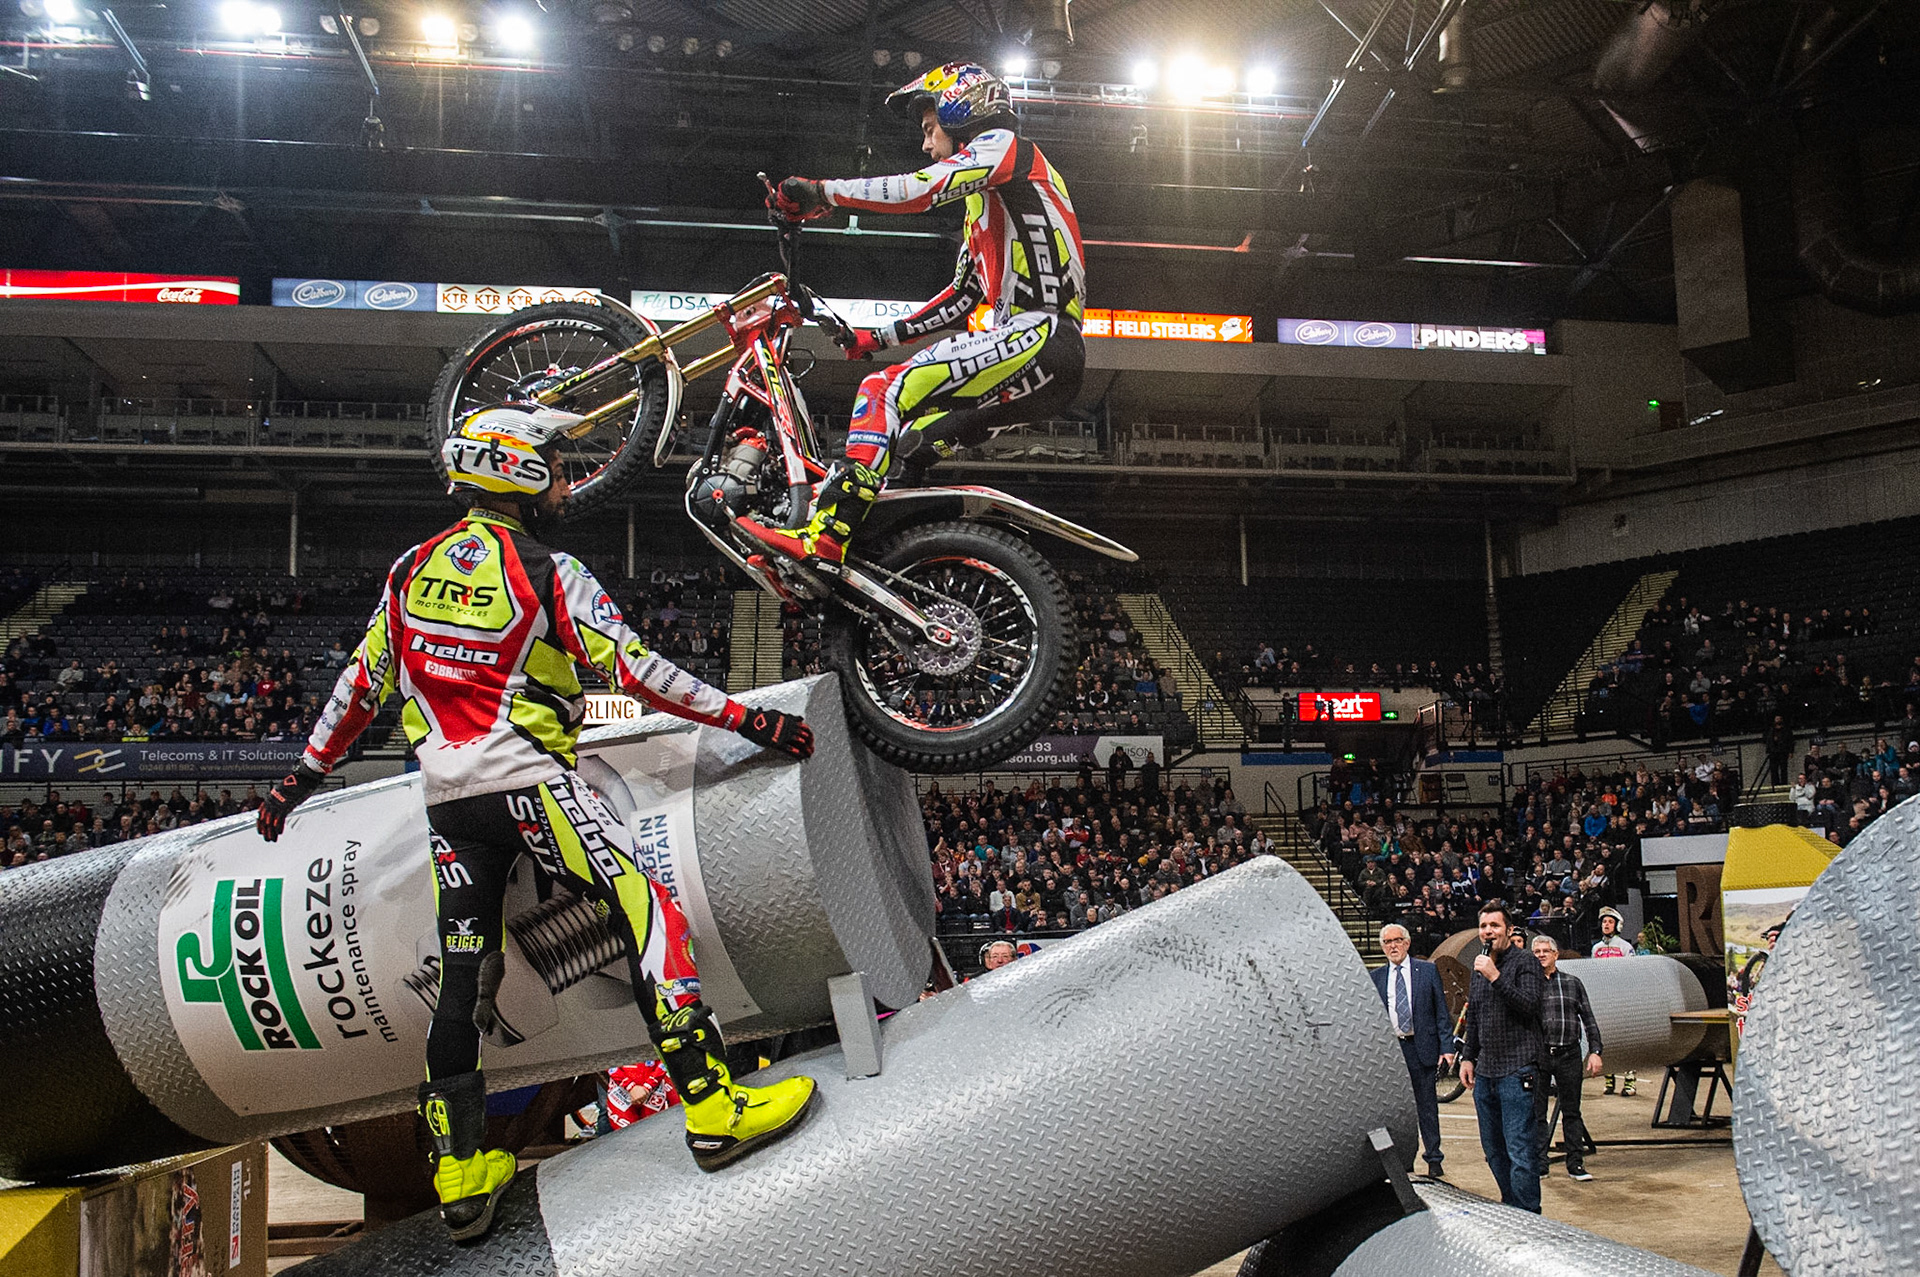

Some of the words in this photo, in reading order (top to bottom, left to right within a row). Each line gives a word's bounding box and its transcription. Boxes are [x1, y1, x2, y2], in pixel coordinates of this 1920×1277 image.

[943, 78, 971, 103] Red
[932, 175, 988, 203] hebo
[298, 285, 338, 302] Cadbury
[369, 288, 410, 305] Cadbury
[442, 293, 468, 304] KTR
[474, 294, 501, 306] KTR
[507, 295, 533, 307] KTR
[669, 295, 711, 310] DSA
[874, 302, 913, 317] DSA
[905, 293, 973, 336] hebo
[1151, 321, 1216, 340] STEELERS
[1420, 328, 1528, 350] PINDERS
[950, 328, 1042, 381] hebo
[848, 433, 888, 444] MICHELIN
[410, 634, 500, 667] hebo
[140, 749, 205, 762] Telecoms
[208, 749, 219, 761] &
[221, 749, 235, 761] IT
[238, 749, 302, 762] Solutions
[639, 817, 653, 839] IN
[653, 813, 679, 898] BRITAIN
[340, 839, 362, 895] spray
[235, 878, 262, 940] OIL
[302, 856, 369, 1040] rockeze
[340, 904, 399, 1043] maintenance
[235, 947, 297, 1050] ROCK
